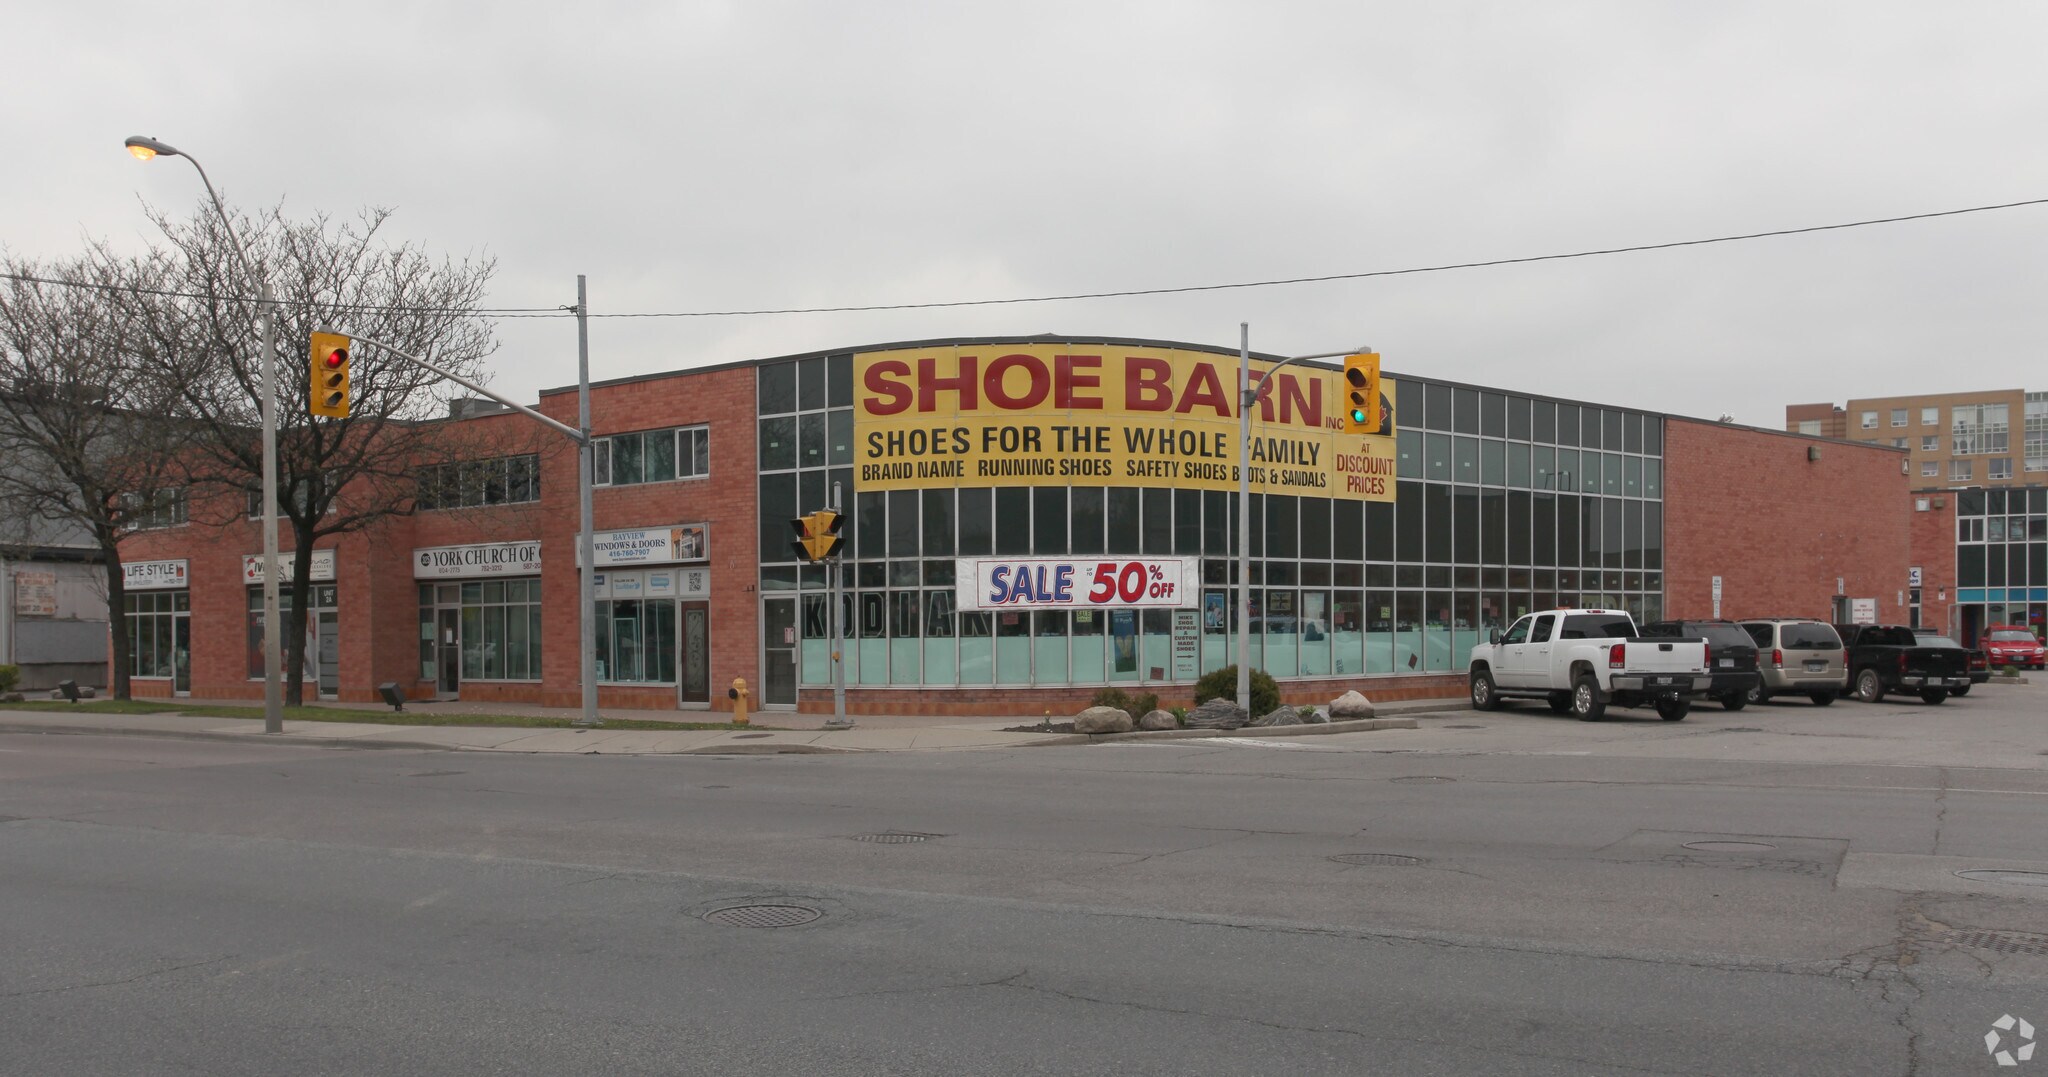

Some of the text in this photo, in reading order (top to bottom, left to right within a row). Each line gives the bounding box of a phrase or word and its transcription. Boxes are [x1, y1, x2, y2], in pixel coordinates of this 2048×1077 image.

[863, 354, 1104, 416] SHOE
[1125, 357, 1322, 427] BARN
[867, 426, 1321, 466] SHOES FOR THE WHOLE AMILY
[1360, 443, 1370, 454] AT
[862, 458, 1326, 488] BRAND NAME RUNNING SHOES SAFETY SHOES BOTS & SANDALS
[1336, 454, 1394, 476] DISCOUNT
[1347, 475, 1385, 495] PRICES
[594, 539, 666, 551] WINDOWS & DOORS
[612, 532, 646, 541] BAYVIEW
[433, 551, 463, 567] YORK
[465, 547, 517, 565] CHURCH
[519, 546, 536, 562] OF
[608, 549, 650, 557] 416-760-7907
[127, 565, 144, 576] LIFE
[147, 563, 174, 576] STYLE
[989, 564, 1075, 604] SALE
[1088, 561, 1148, 603] 50
[1149, 582, 1175, 599] OFF
[323, 589, 334, 597] UNIT
